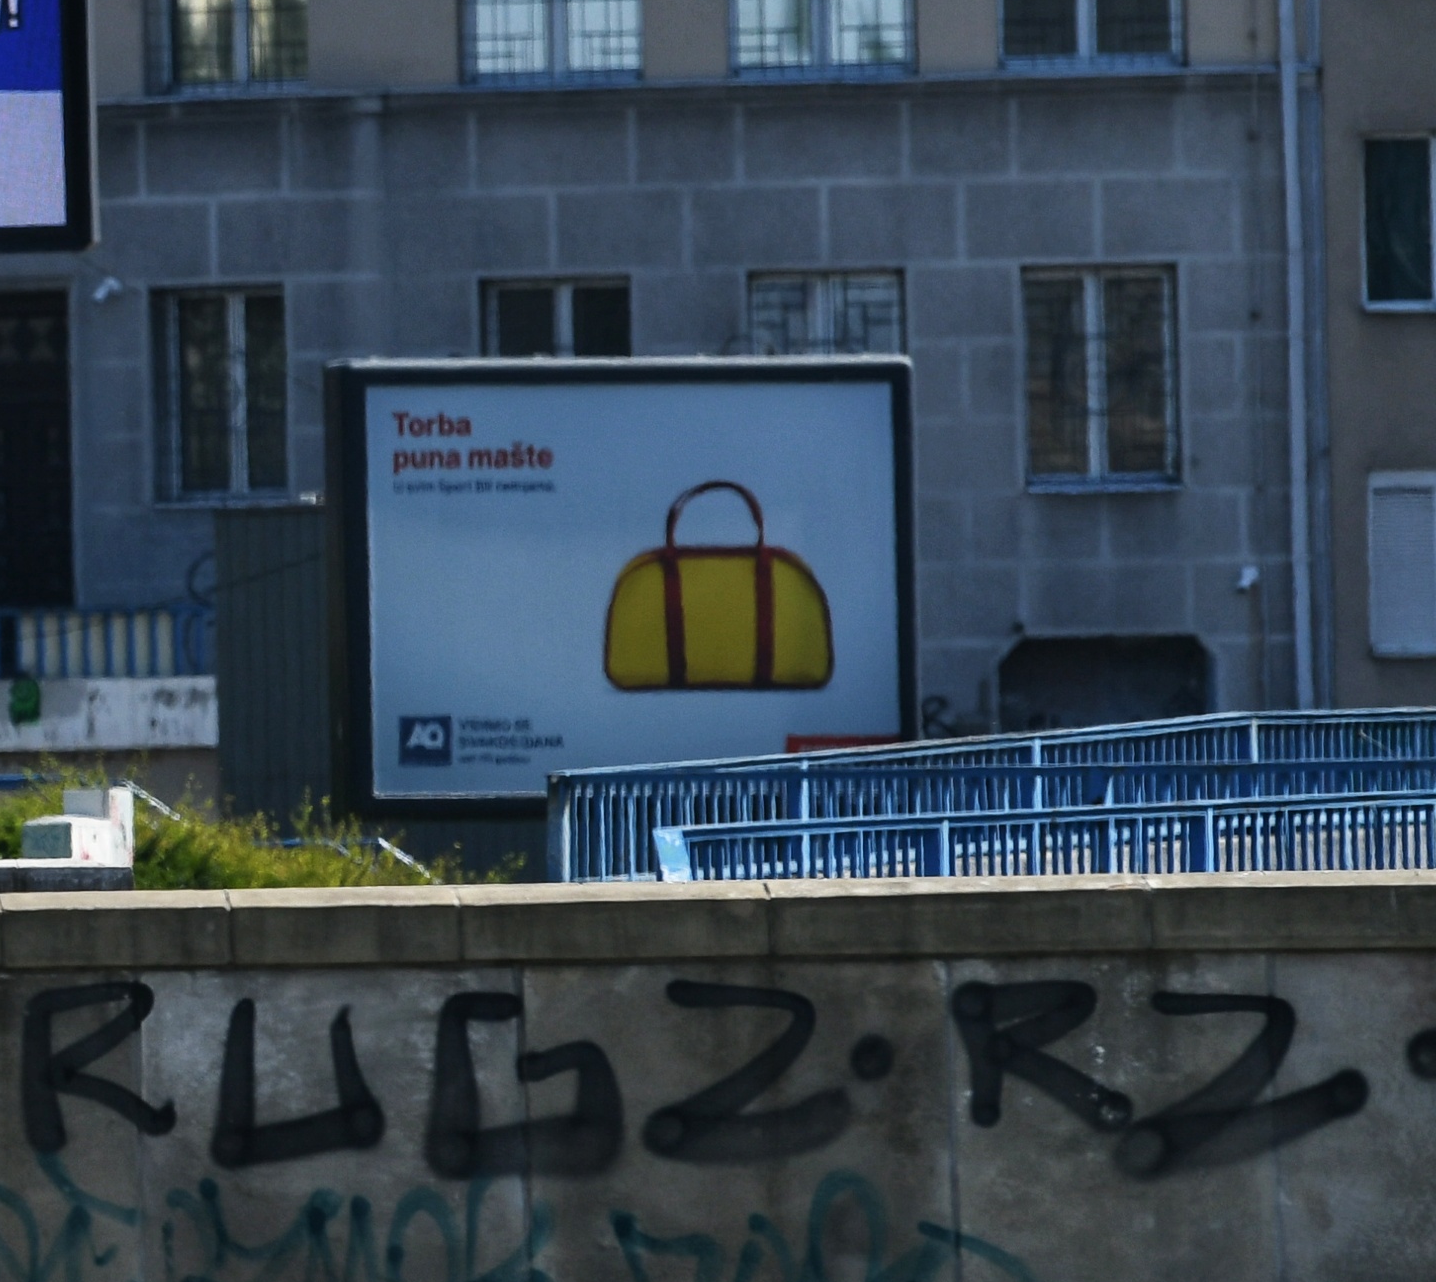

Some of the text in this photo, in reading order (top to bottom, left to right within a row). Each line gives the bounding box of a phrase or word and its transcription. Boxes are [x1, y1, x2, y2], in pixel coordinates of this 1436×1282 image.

[393, 411, 472, 437] Torba
[393, 440, 555, 475] puna mašte
